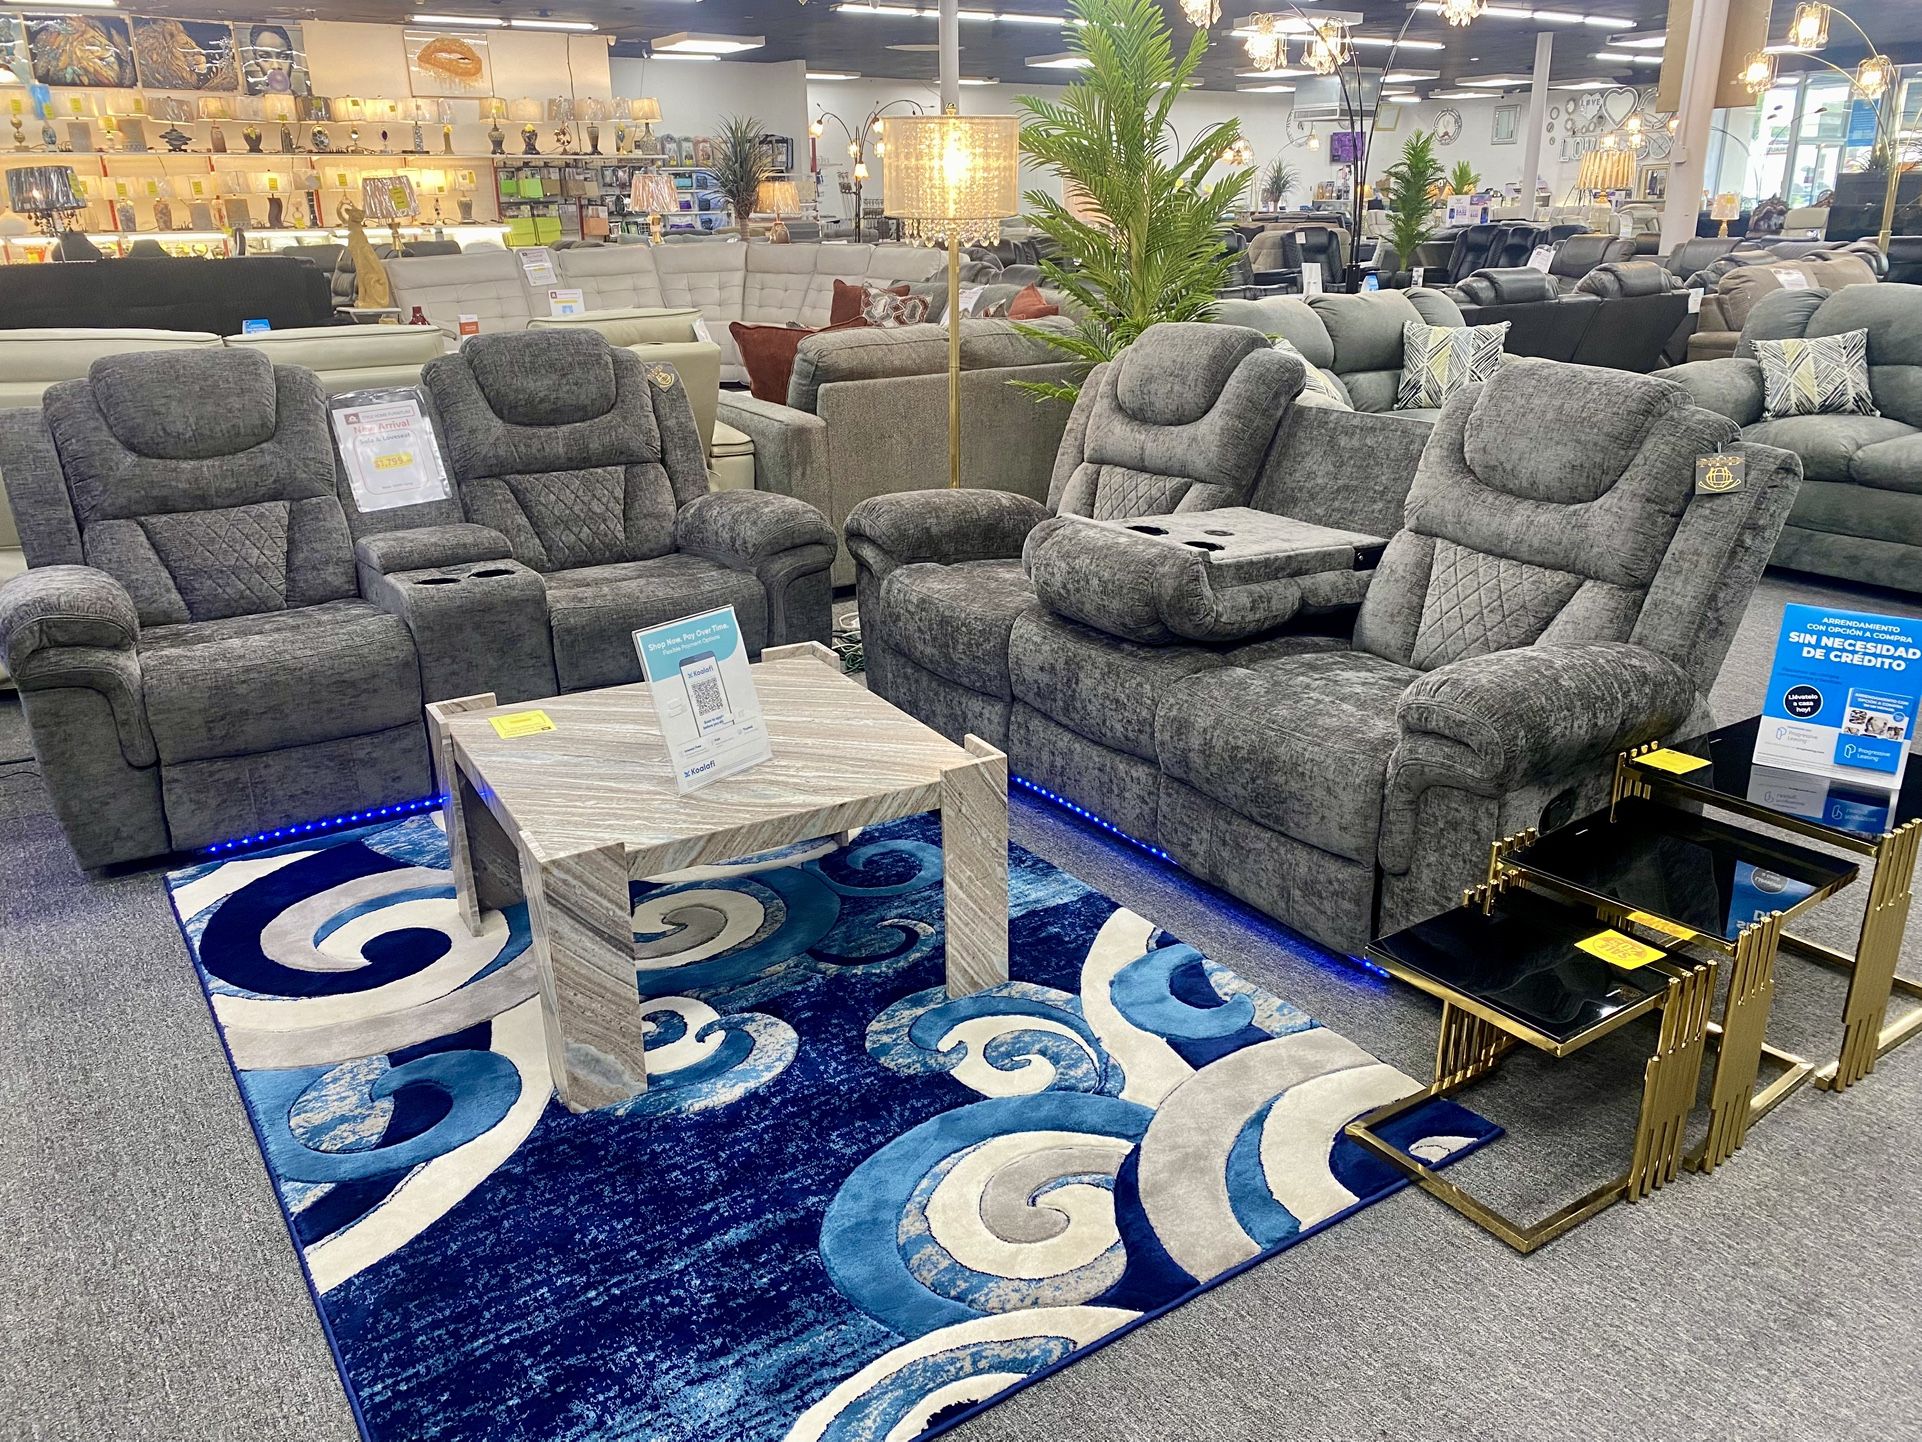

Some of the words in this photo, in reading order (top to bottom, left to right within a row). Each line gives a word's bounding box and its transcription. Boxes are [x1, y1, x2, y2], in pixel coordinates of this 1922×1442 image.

[378, 418, 410, 431] Arrival
[382, 431, 410, 441] Loveseat
[1822, 617, 1901, 633] ARRENDAMIENTO
[648, 640, 666, 652] Shop
[666, 637, 683, 647] Now.
[683, 632, 695, 642] Pay
[695, 627, 711, 637] Over
[711, 623, 730, 634] Time.
[1807, 623, 1826, 632] CON
[1828, 625, 1863, 637] OPCIÓN
[1864, 630, 1872, 638] A
[1873, 632, 1913, 644] COMPRA
[662, 646, 681, 656] Flexible
[681, 640, 701, 650] Payment
[701, 634, 721, 645] Options
[1788, 631, 1817, 645] SIN
[1821, 636, 1922, 659] NECESIDAD
[1802, 646, 1826, 660] DE
[1829, 651, 1906, 671] CRÉDITO
[693, 665, 714, 677] Koalafi
[1857, 753, 1879, 762] Leasing
[1858, 748, 1891, 757] Progressive
[691, 760, 716, 776] Koalafi
